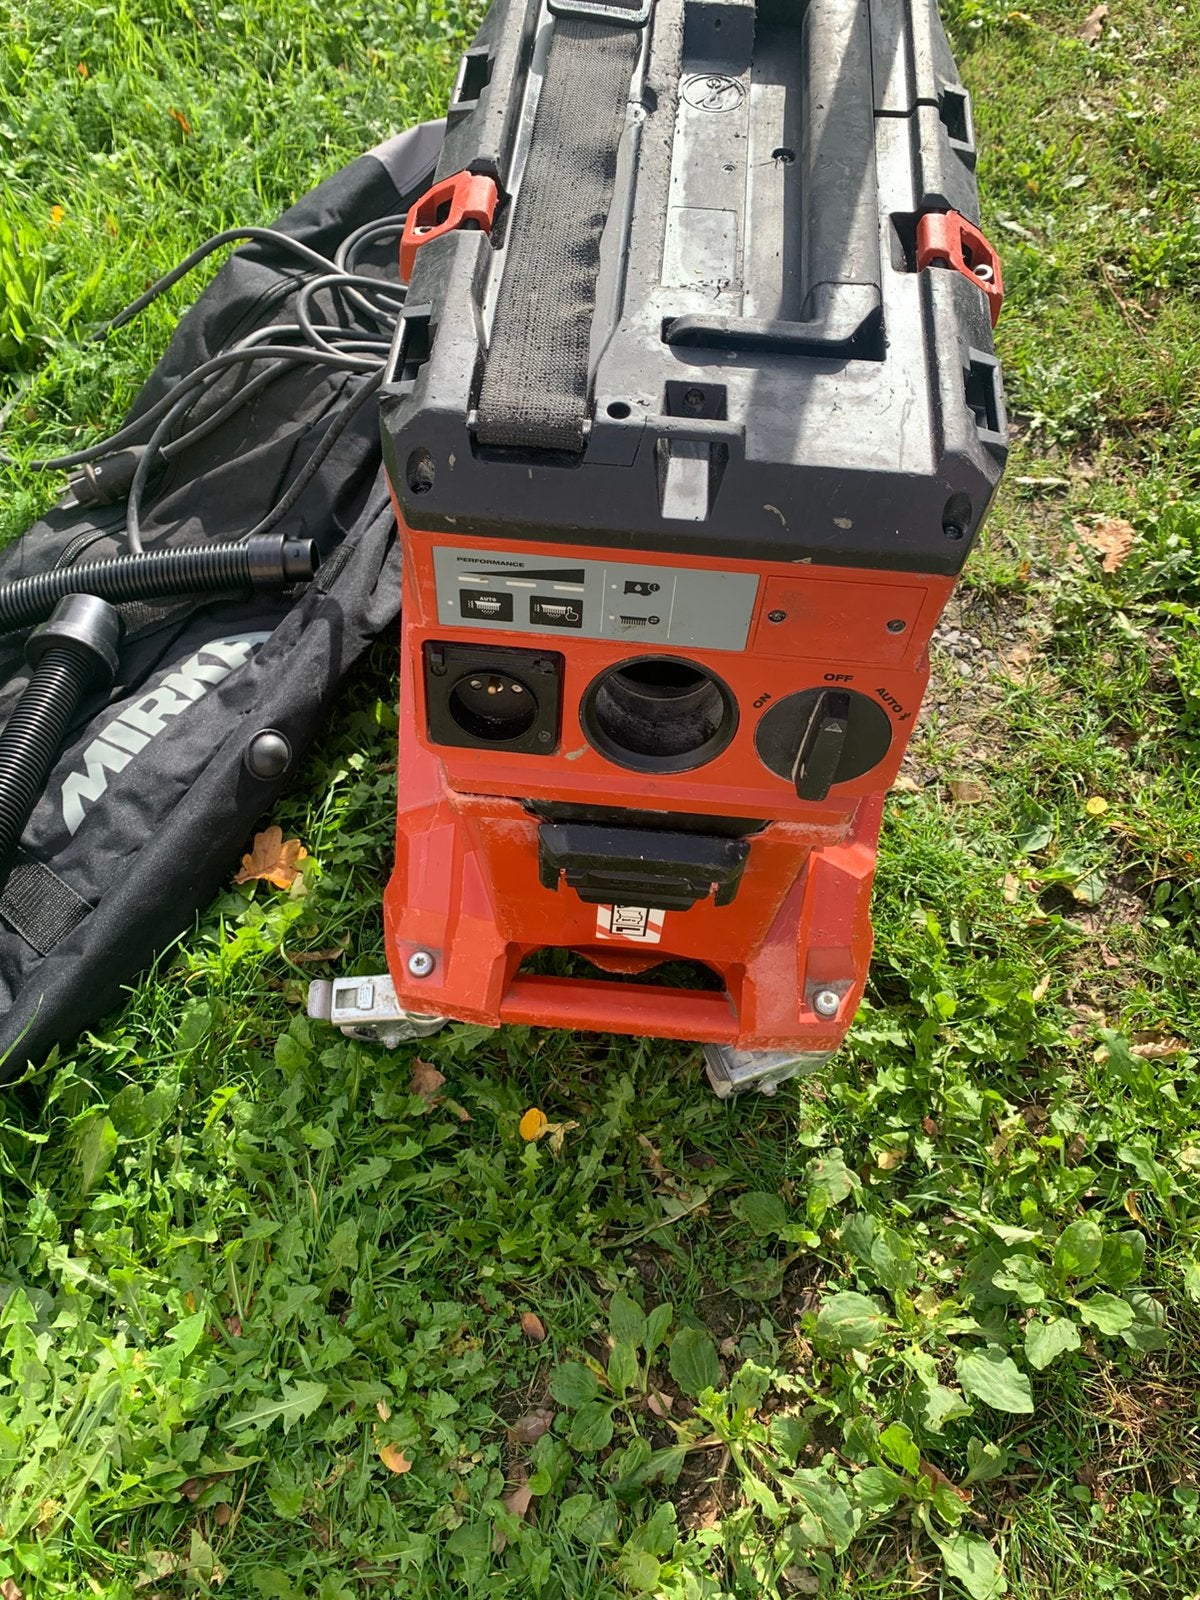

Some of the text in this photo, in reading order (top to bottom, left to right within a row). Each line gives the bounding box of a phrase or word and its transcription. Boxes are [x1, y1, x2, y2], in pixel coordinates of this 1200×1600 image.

[456, 556, 525, 568] PERFORMANCE
[823, 673, 854, 682] OFF
[752, 692, 772, 709] ON
[875, 687, 904, 714] AUTO
